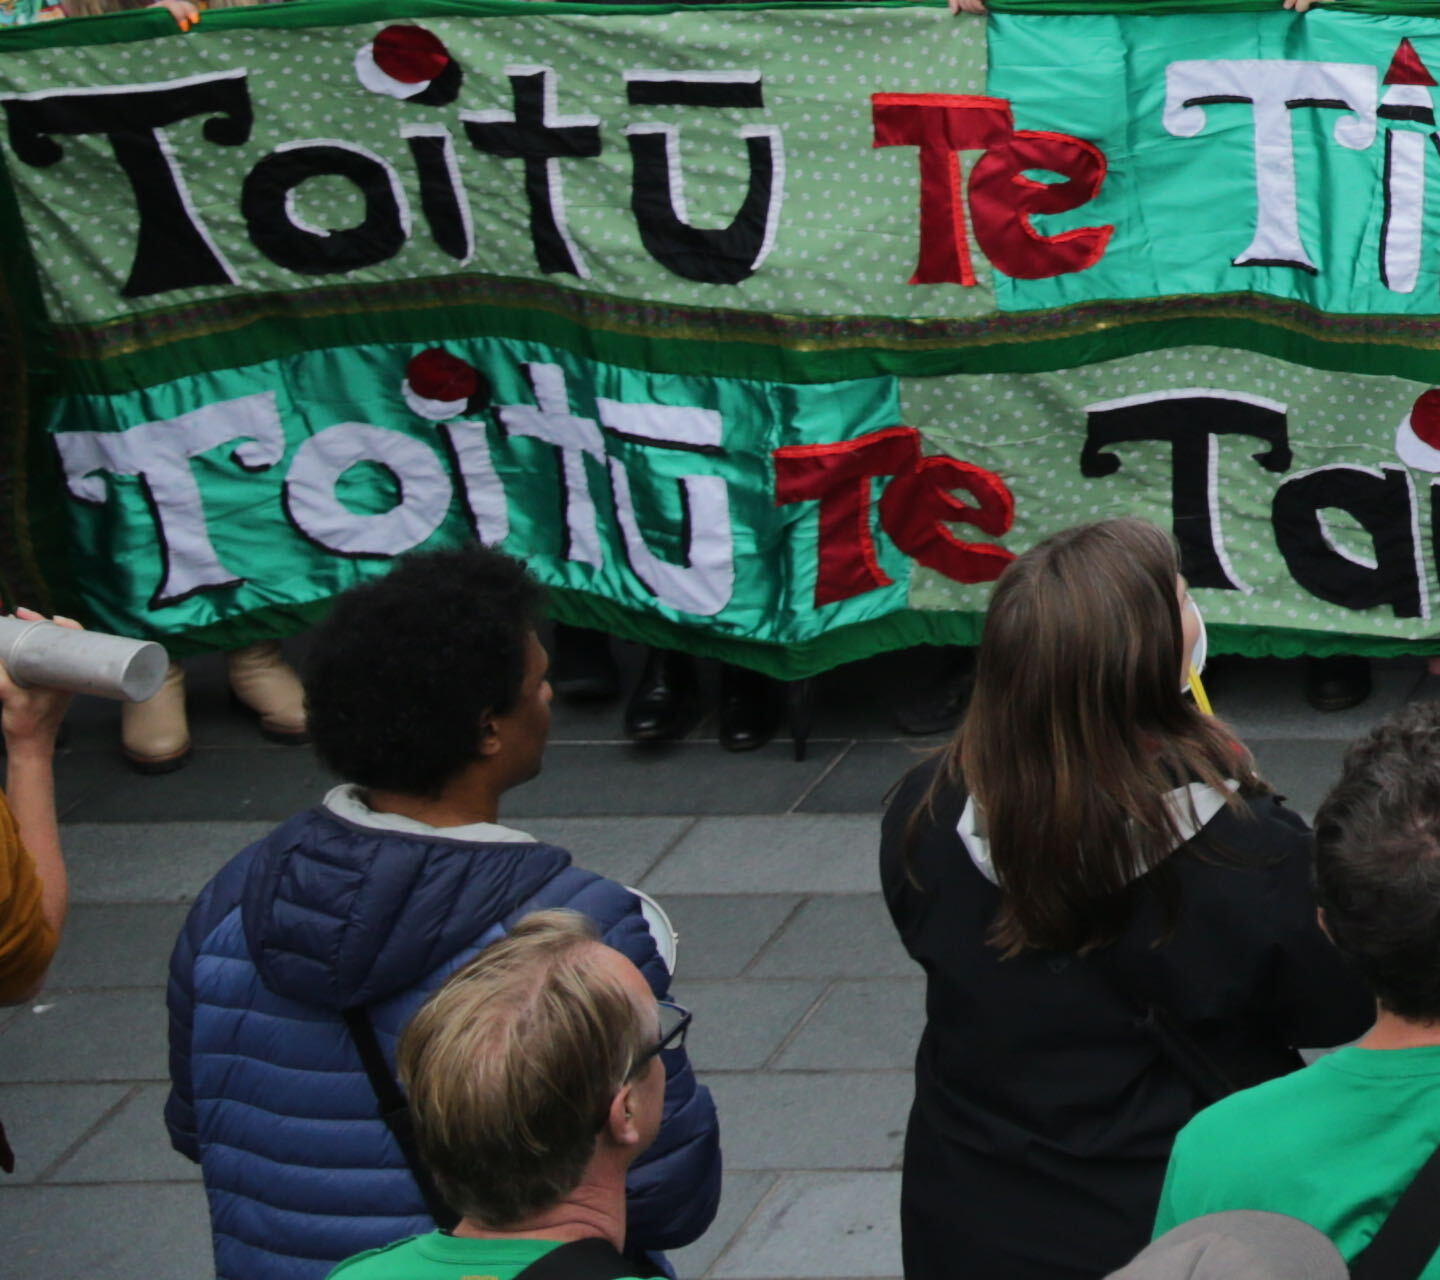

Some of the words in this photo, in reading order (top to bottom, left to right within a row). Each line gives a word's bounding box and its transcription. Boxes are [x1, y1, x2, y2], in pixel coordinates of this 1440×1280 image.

[0, 24, 781, 299] Toitū
[869, 87, 1116, 290] Te
[59, 346, 734, 615] Toitū
[775, 421, 1016, 612] Te
